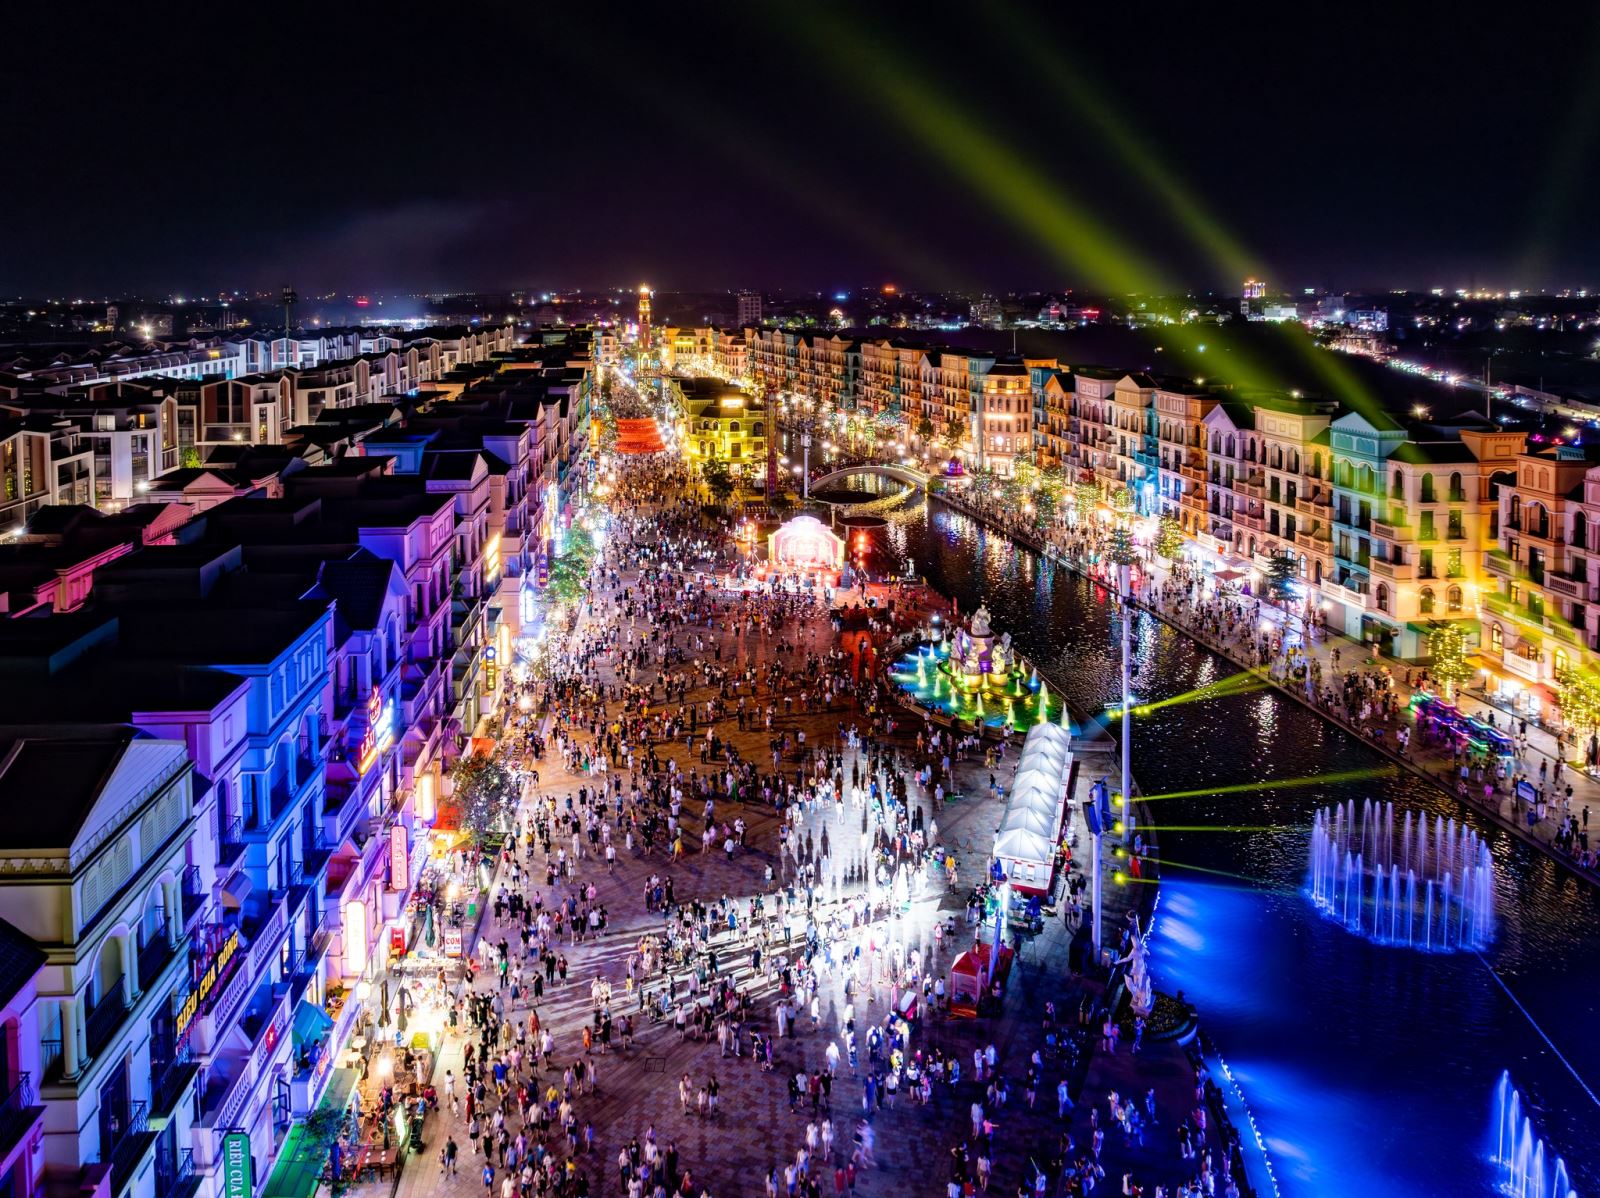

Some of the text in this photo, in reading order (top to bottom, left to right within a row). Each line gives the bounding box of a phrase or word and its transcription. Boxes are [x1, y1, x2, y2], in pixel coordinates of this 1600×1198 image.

[200, 963, 216, 1001] CUA
[229, 1141, 245, 1167] RIÊU
[230, 1170, 244, 1192] CUA
